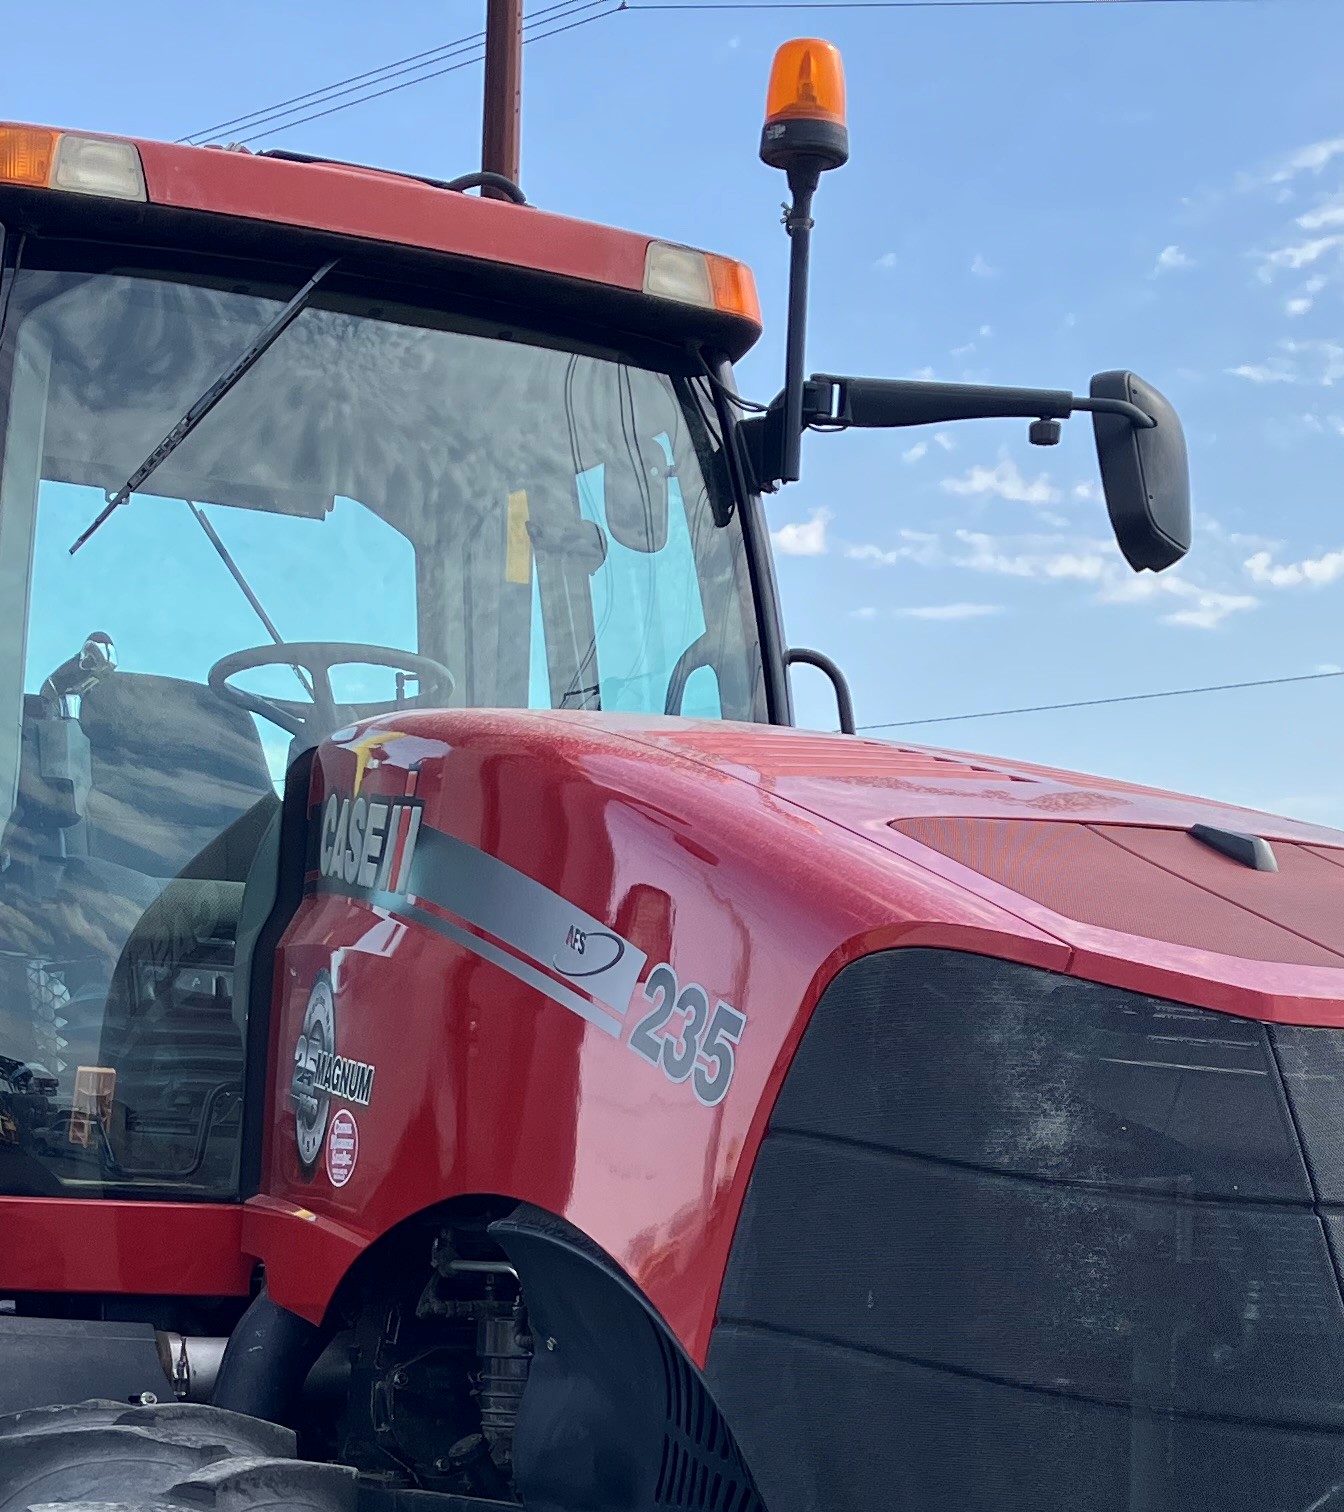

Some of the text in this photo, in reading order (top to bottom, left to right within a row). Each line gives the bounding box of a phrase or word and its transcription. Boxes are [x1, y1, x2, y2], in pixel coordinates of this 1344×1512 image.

[320, 793, 389, 888] CASE
[565, 925, 586, 955] AFS
[627, 962, 747, 1107] 235
[313, 1049, 375, 1106] MAGNUM
